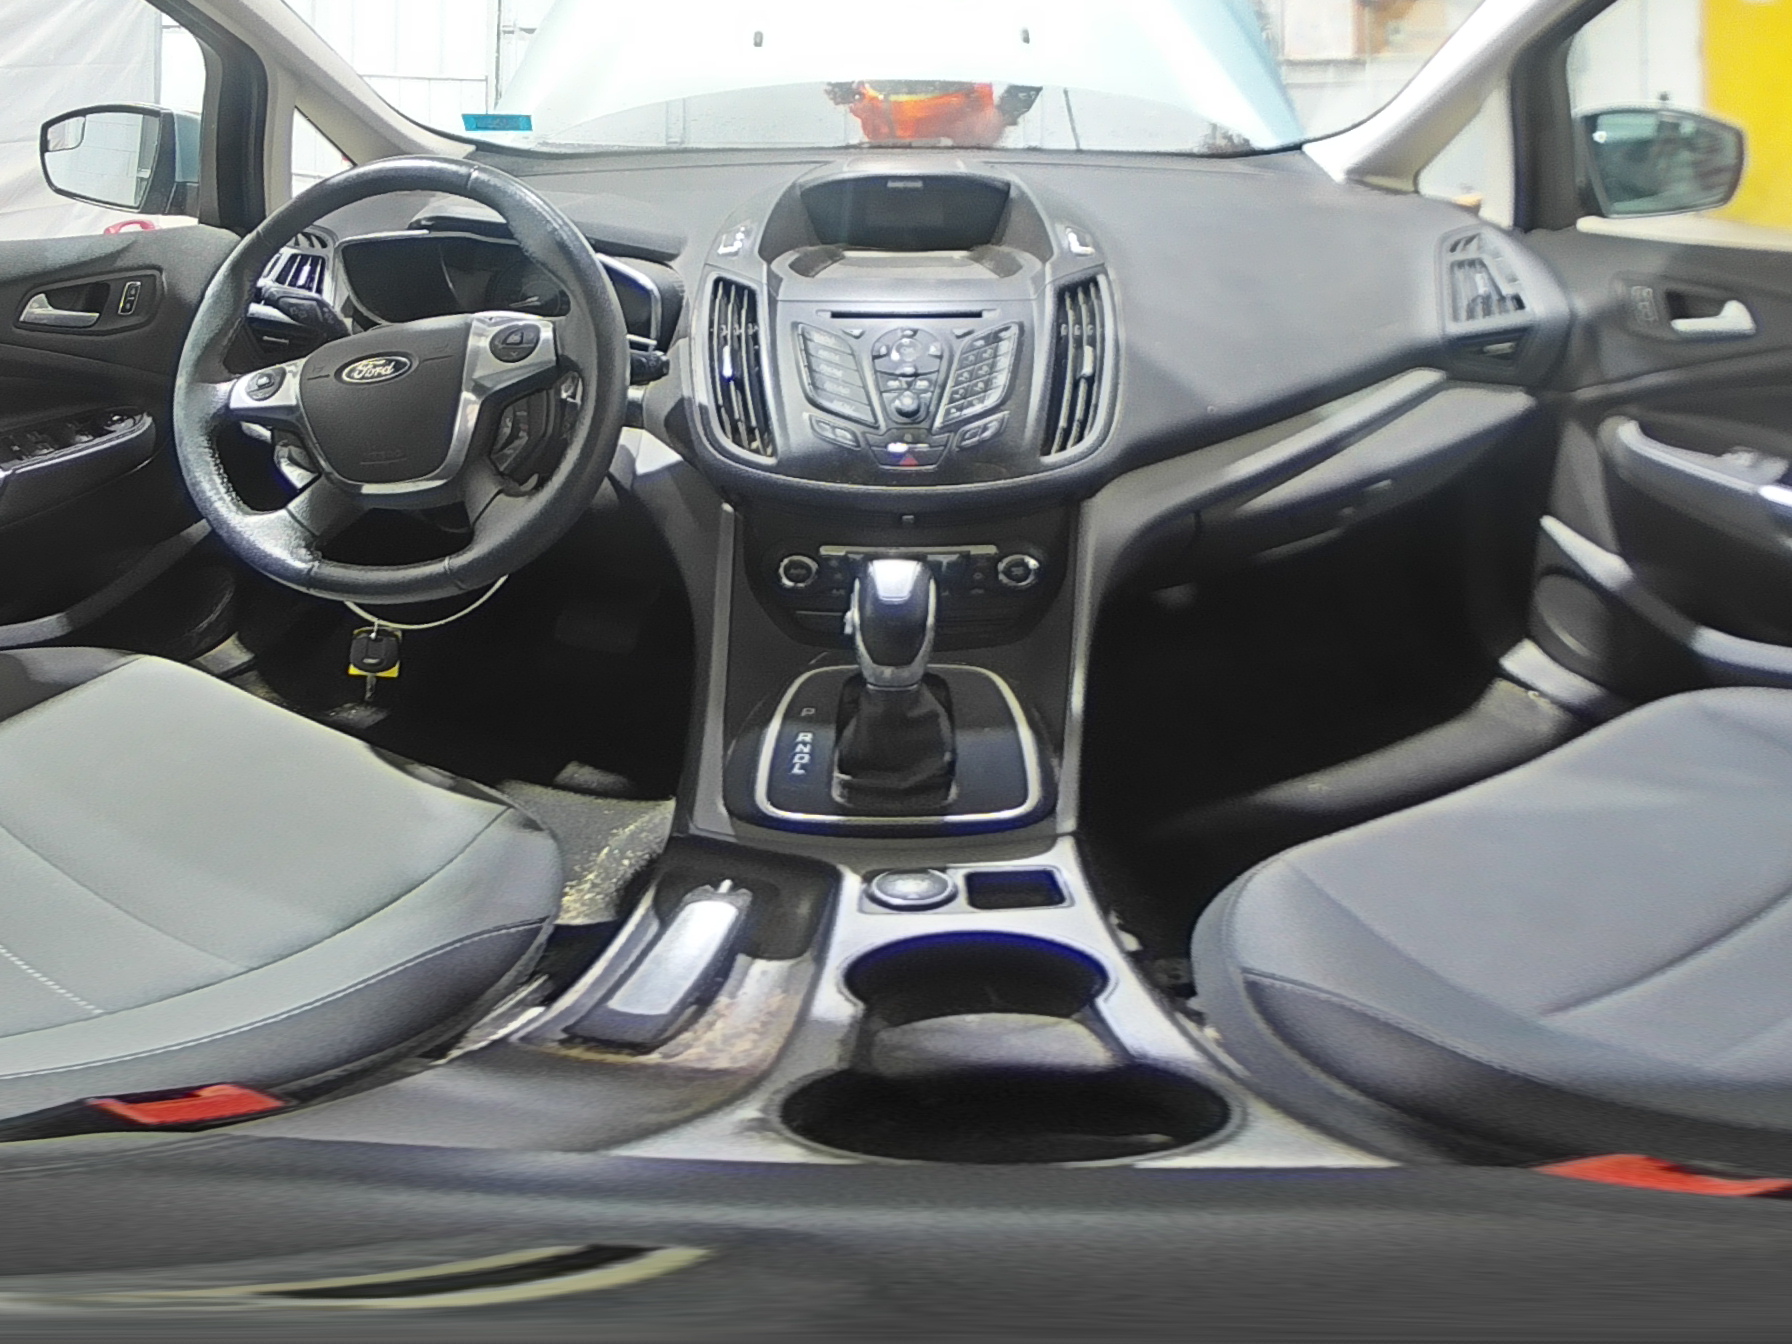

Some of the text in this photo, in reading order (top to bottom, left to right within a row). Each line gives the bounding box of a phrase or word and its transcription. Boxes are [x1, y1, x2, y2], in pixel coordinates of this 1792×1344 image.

[353, 359, 396, 379] Ford
[791, 707, 816, 774] P R N D L
